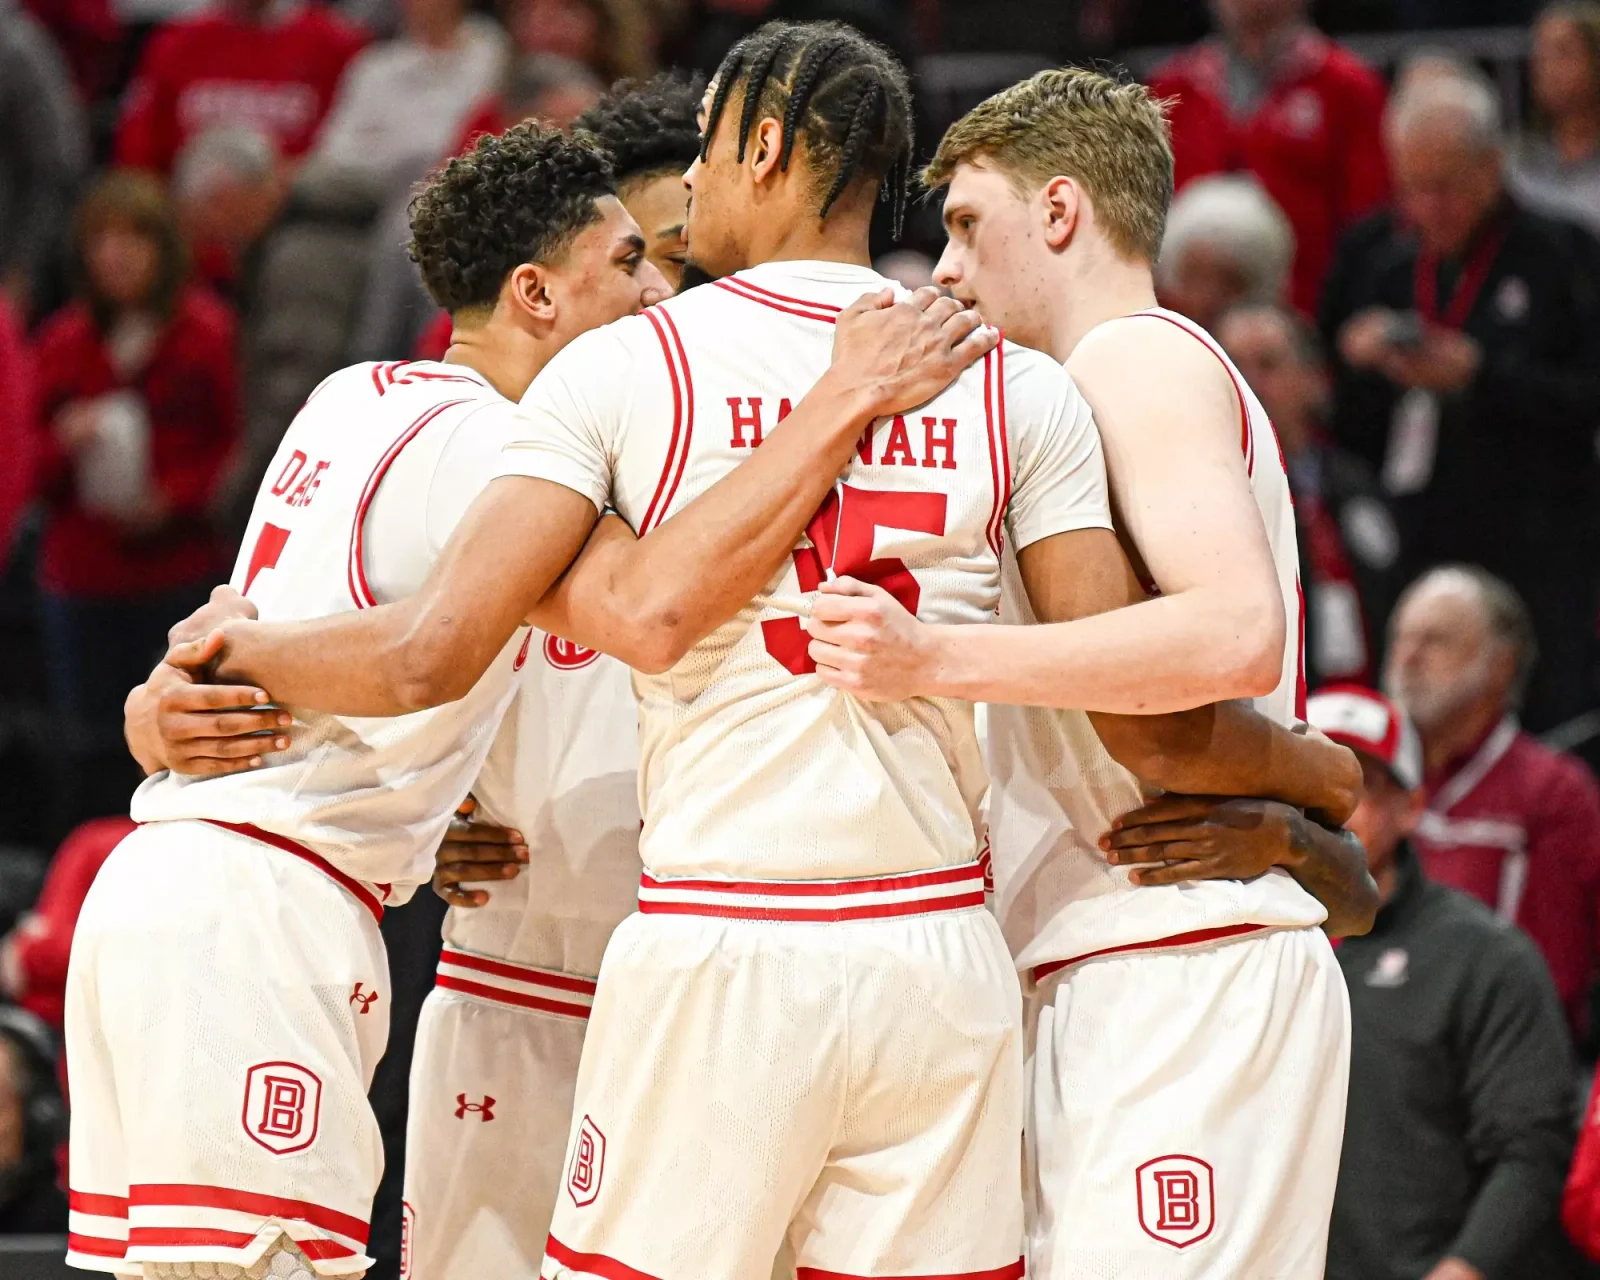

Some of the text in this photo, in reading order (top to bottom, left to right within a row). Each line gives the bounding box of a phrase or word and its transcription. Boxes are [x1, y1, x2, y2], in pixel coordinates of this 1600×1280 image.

[726, 397, 958, 469] HNAH
[258, 1075, 306, 1139] B
[572, 1128, 594, 1192] B
[1153, 1170, 1200, 1230] B
